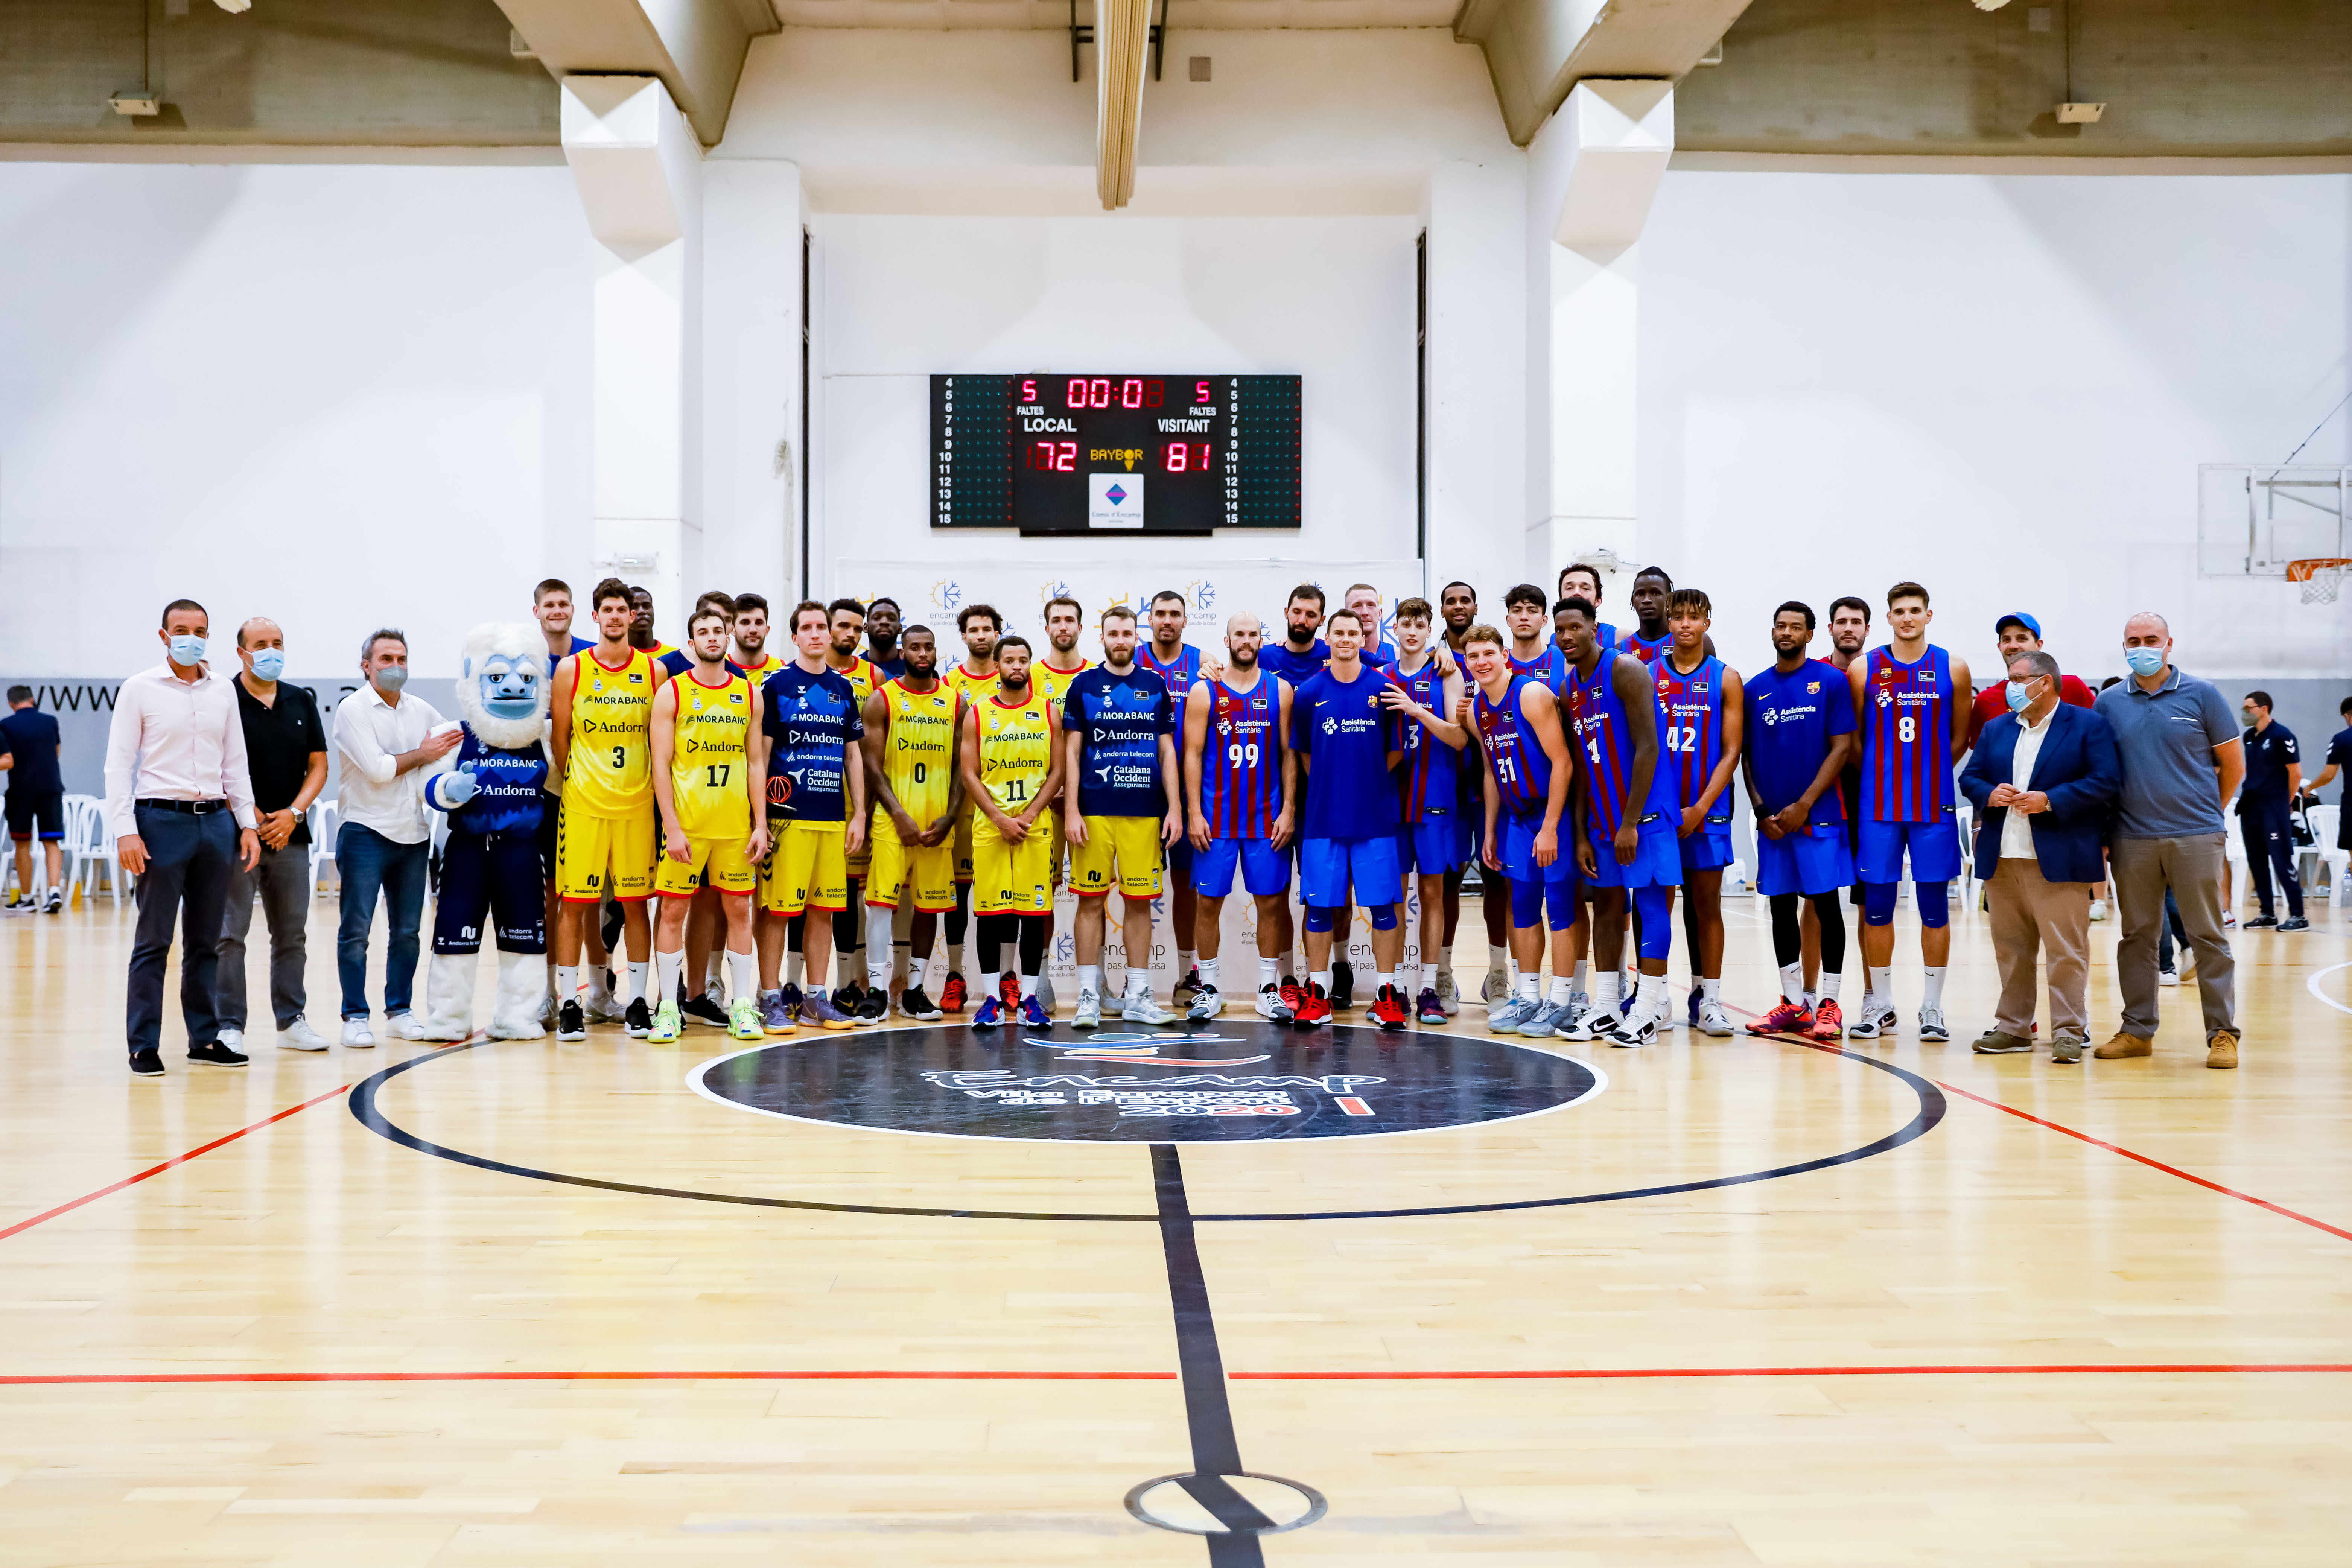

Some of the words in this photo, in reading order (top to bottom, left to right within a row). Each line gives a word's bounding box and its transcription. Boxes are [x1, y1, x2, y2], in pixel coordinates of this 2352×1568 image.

[945, 378, 953, 387] 4
[1231, 378, 1237, 387] 4
[945, 390, 953, 400] 5
[1022, 380, 1037, 402] 5
[1196, 381, 1210, 403] 5
[1231, 390, 1238, 400] 5
[945, 402, 952, 412] 6
[1017, 406, 1044, 415] FALTES
[1189, 406, 1216, 416] FALTES
[1231, 403, 1238, 412] 6
[945, 415, 952, 424] 7
[1231, 415, 1238, 424] 7
[1024, 418, 1077, 432] LOCAL
[1158, 418, 1210, 433] VISITANT
[945, 427, 952, 437] 8
[1231, 427, 1238, 437] 8
[944, 440, 952, 449] 9
[1231, 440, 1238, 449] 9
[939, 452, 952, 462] 10
[1037, 441, 1077, 471] 72
[1091, 449, 1143, 462] BAYBOR
[1167, 443, 1211, 472] 81
[1225, 452, 1238, 462] 10
[939, 464, 950, 474] 11
[1225, 464, 1237, 474] 11
[939, 477, 951, 486] 12
[1225, 477, 1238, 486] 12
[939, 489, 951, 499] 13
[1225, 489, 1238, 499] 13
[938, 501, 951, 511] 14
[1225, 501, 1238, 511] 14
[938, 514, 951, 523] 15
[1225, 514, 1238, 523] 15
[595, 696, 648, 705] MORABANC
[1672, 703, 1711, 711] Assistència
[1780, 706, 1816, 715] Assistència
[697, 715, 746, 725] MORABANC
[799, 713, 844, 725] MORABANC
[1103, 712, 1154, 721] MORABANC
[1899, 716, 1915, 742] 8
[802, 731, 844, 745] Andorra
[994, 732, 1044, 742] MORABANC
[1107, 729, 1154, 741] Andorra
[1666, 727, 1696, 752] 42
[1229, 744, 1259, 768] 99
[1587, 738, 1600, 764] 1
[613, 745, 625, 768] 3
[480, 759, 538, 768] MORABANC
[1000, 757, 1043, 769] Andorra
[808, 769, 840, 779] Catalana
[915, 762, 926, 783] 0
[1114, 765, 1151, 774] Catalana
[1497, 756, 1516, 783] 31
[707, 765, 730, 787] 17
[1113, 774, 1150, 783] Occident
[483, 784, 536, 795] Andorra
[1006, 779, 1027, 802] 11
[1108, 963, 1121, 971] pas
[1360, 962, 1374, 972] pas
[1077, 1090, 1289, 1098] Europea
[998, 1097, 1068, 1105] de
[1117, 1104, 1302, 1116] 2020
